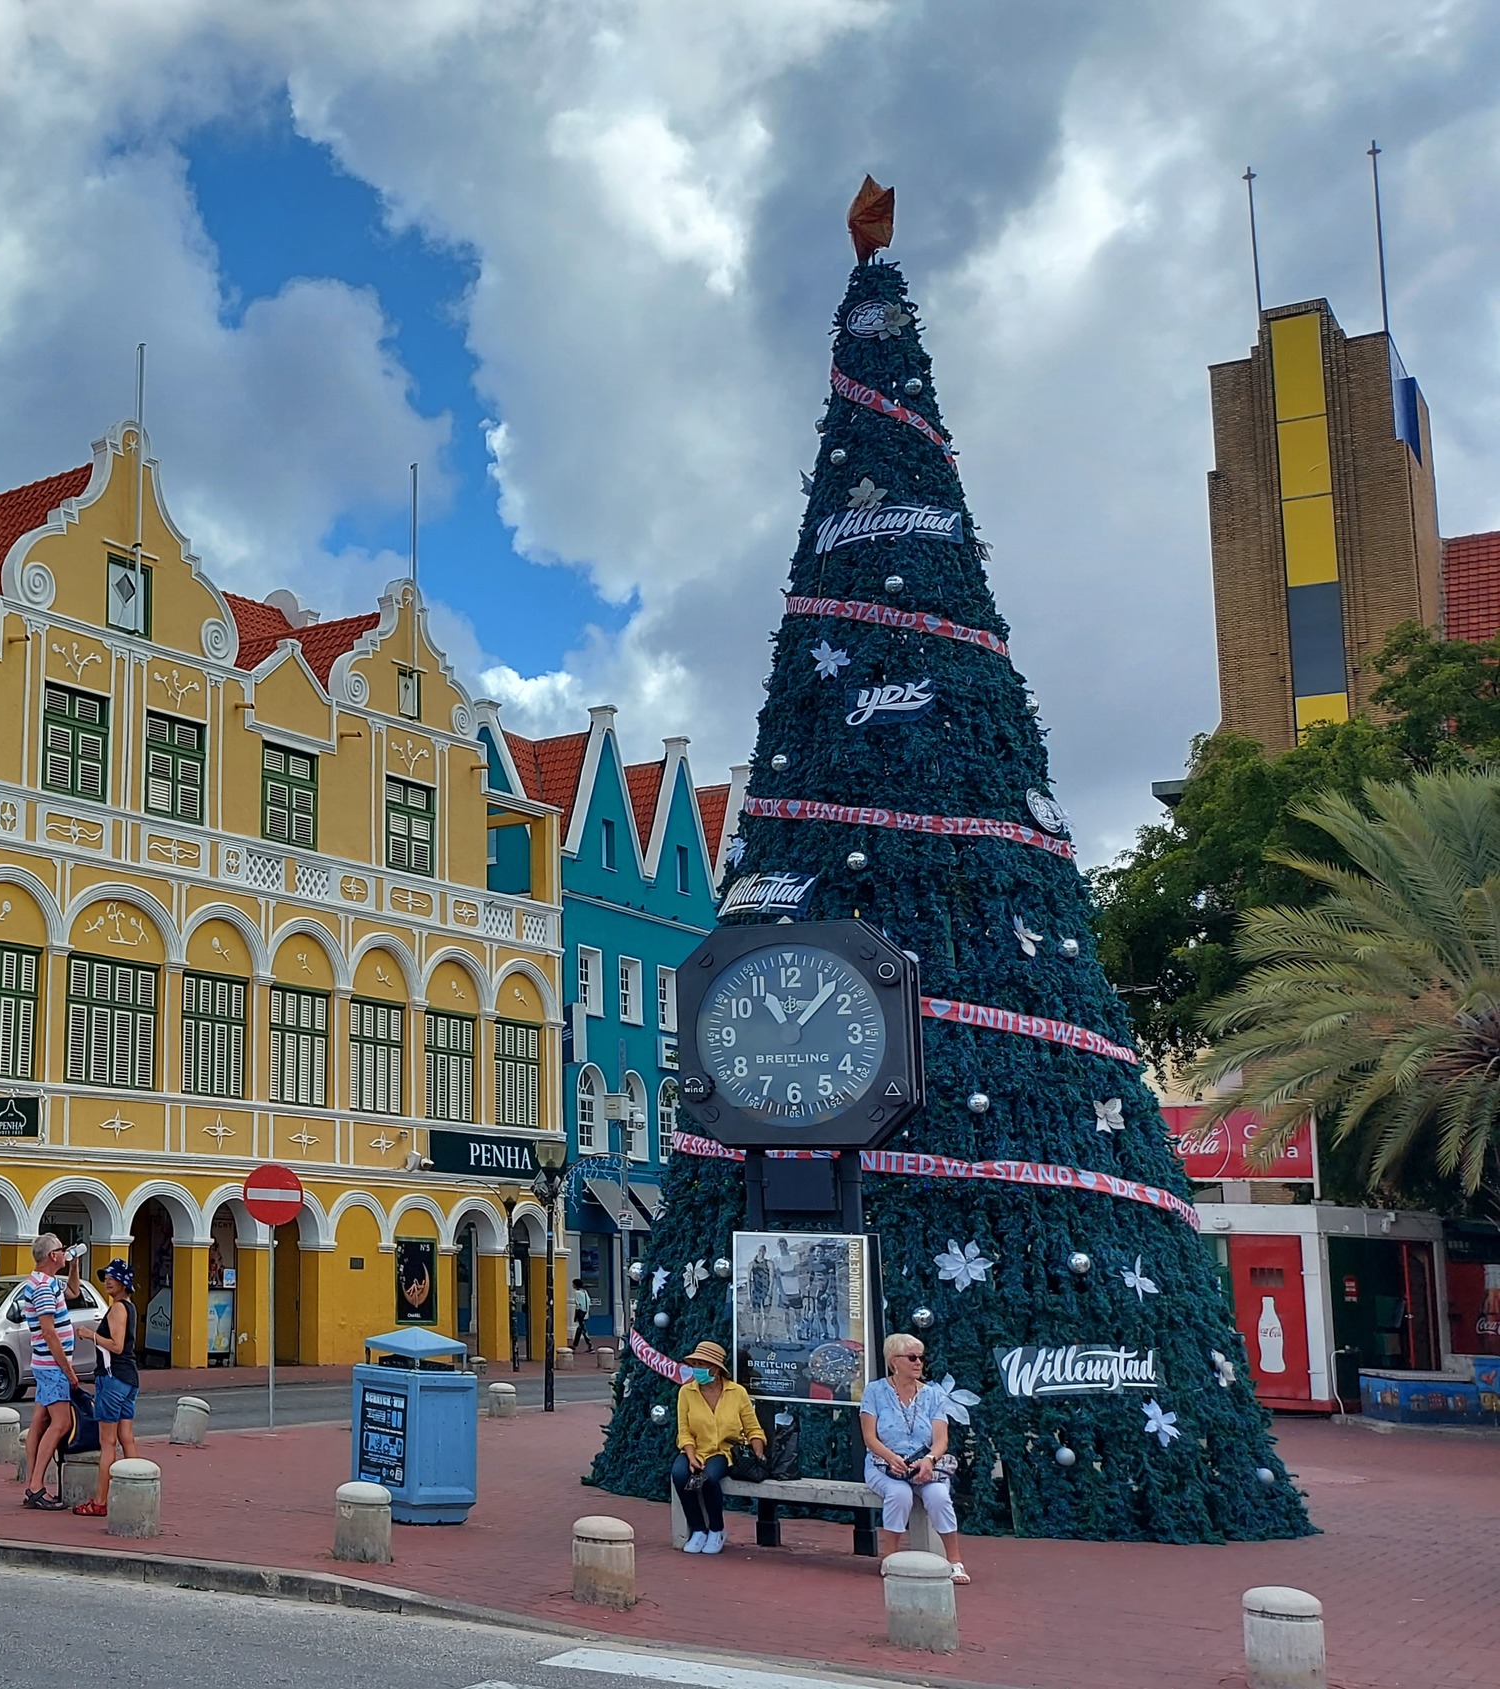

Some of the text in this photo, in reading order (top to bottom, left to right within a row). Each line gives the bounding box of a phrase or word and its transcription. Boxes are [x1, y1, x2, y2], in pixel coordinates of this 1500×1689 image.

[815, 502, 959, 555] Willemstad
[811, 598, 839, 615] WE
[840, 601, 917, 628] STAND
[949, 622, 982, 645] YDK
[759, 799, 782, 817] YDK
[805, 802, 890, 826] UNITED
[895, 811, 933, 832] WE
[940, 816, 1015, 838] STAND
[743, 963, 754, 974] 55
[827, 961, 834, 970] 5
[752, 975, 765, 997] 11
[780, 966, 802, 989] 12
[715, 993, 725, 1004] 50
[857, 987, 866, 997] 10
[731, 997, 752, 1019] 10
[836, 993, 852, 1015] 2
[847, 1022, 863, 1044] 3
[958, 1003, 1048, 1037] UNITED
[1050, 1019, 1081, 1046] WE
[707, 1032, 715, 1043] 45
[721, 1026, 736, 1048] 9
[733, 1056, 748, 1078] 8
[755, 1053, 830, 1064] BREITLING
[837, 1053, 854, 1075] 4
[718, 1070, 728, 1081] 40
[860, 1067, 871, 1079] 20
[683, 1085, 704, 1093] wind
[759, 1075, 773, 1096] 7
[786, 1082, 802, 1104] 6
[817, 1074, 833, 1096] 5
[748, 1096, 760, 1110] 35
[789, 1110, 801, 1118] 30
[830, 1097, 842, 1109] 25
[468, 1142, 534, 1170] PENHA
[858, 1150, 937, 1175] NITED
[942, 1156, 986, 1177] WE
[993, 1161, 1073, 1185] STAND
[1102, 1174, 1142, 1201] YDK
[848, 1241, 861, 1319] ENDURANCE PRO
[747, 1360, 798, 1370] BREITLING
[1001, 1345, 1158, 1396] Willemstad
